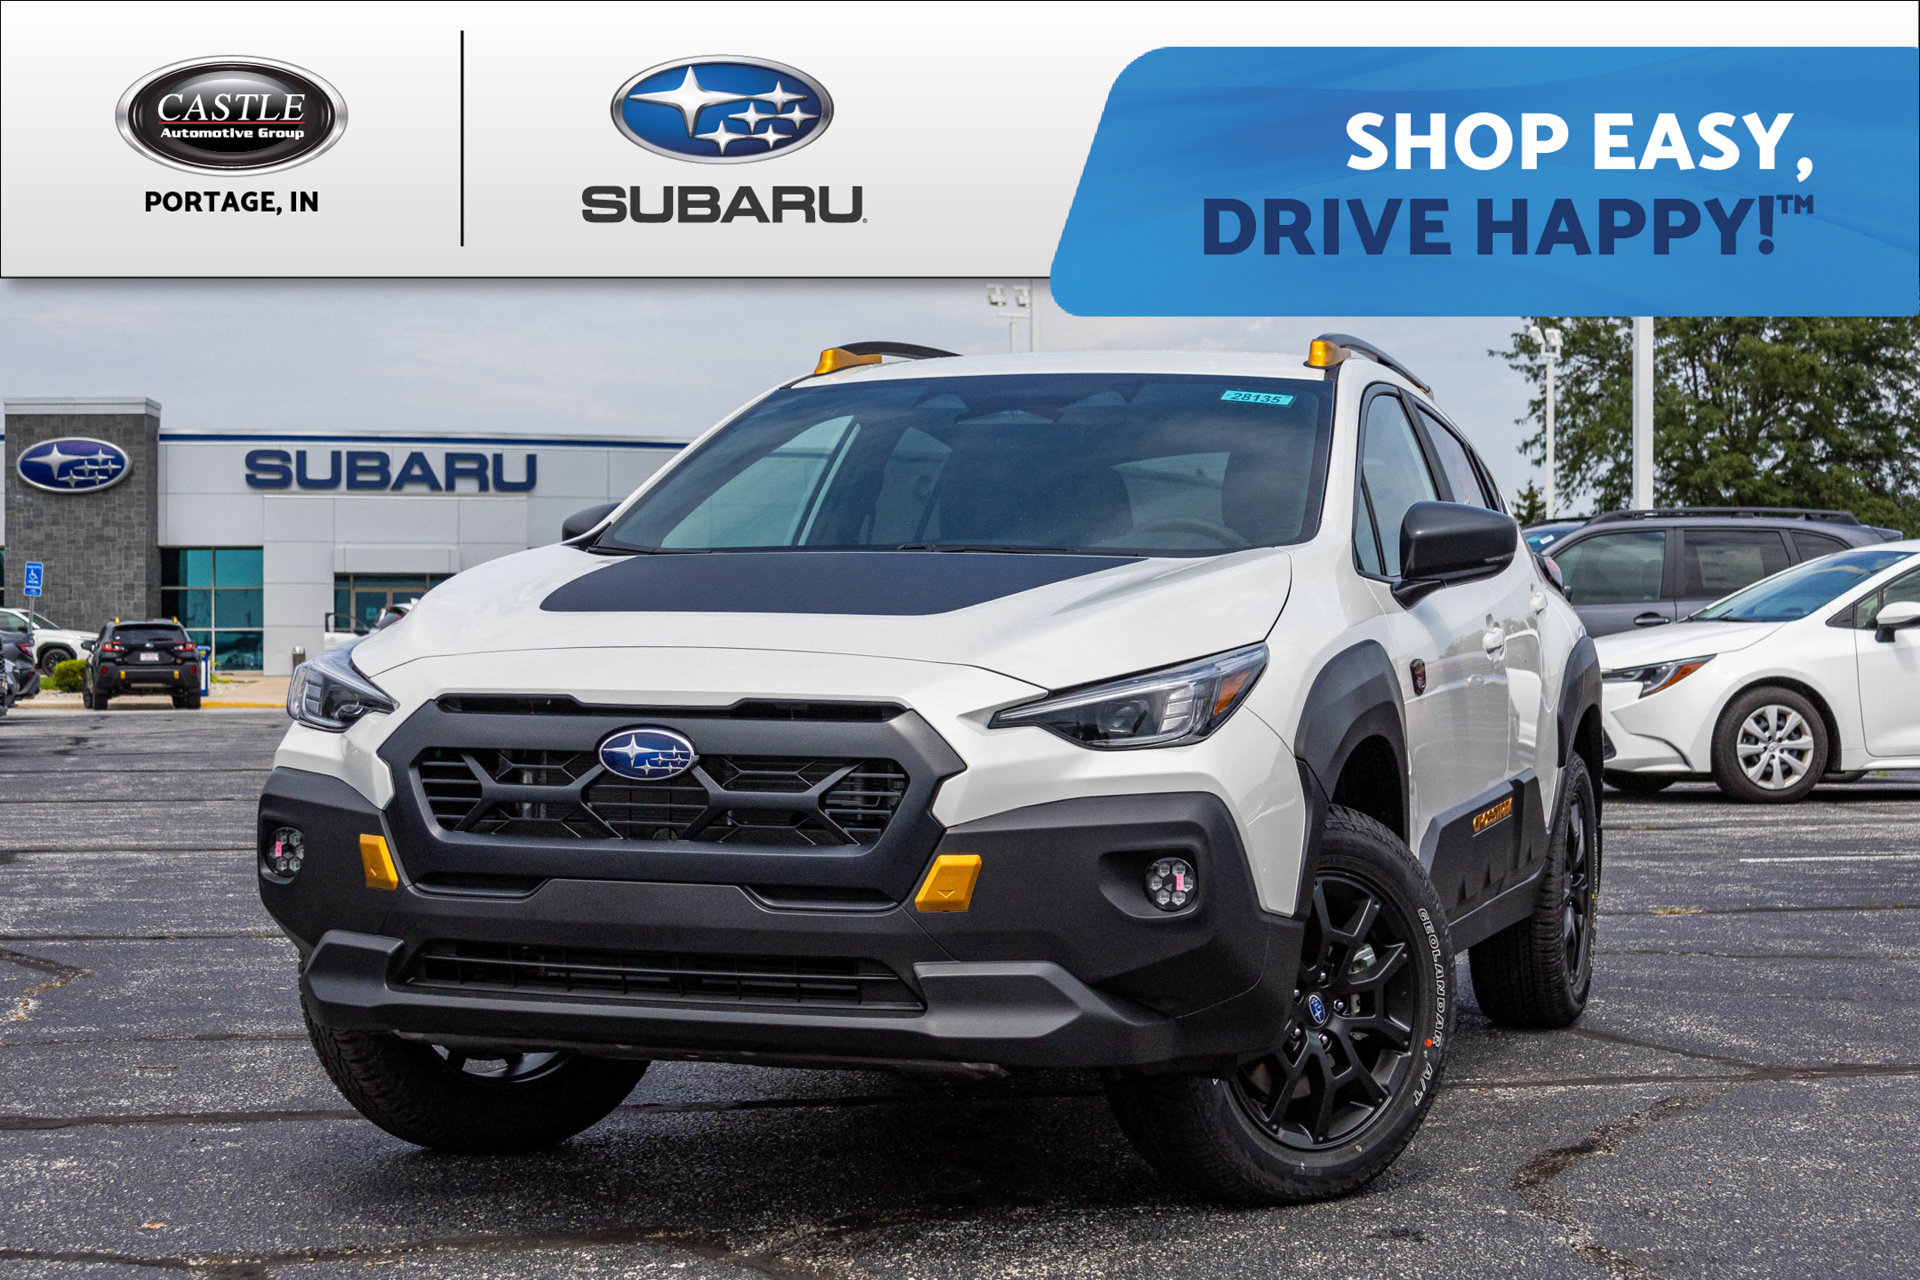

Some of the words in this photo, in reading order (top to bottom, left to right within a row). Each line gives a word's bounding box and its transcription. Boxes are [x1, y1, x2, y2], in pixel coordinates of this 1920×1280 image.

[1230, 392, 1282, 404] 28135
[245, 449, 537, 493] SUBARU
[1418, 908, 1446, 1048] GEOLANDAR
[1413, 1062, 1434, 1107] A/T
